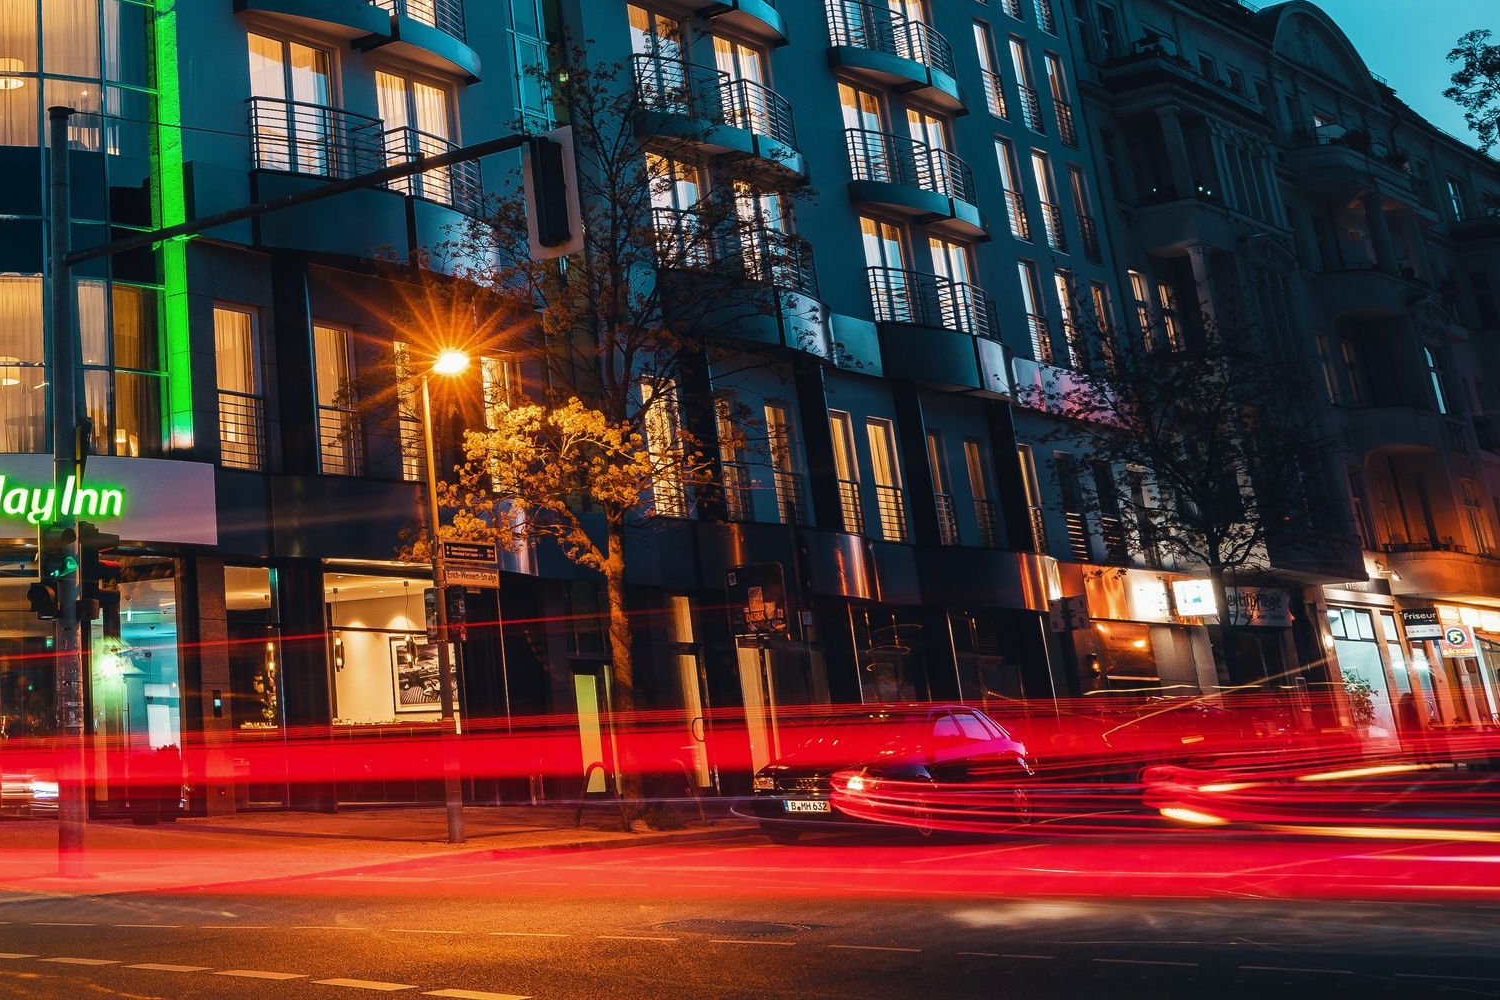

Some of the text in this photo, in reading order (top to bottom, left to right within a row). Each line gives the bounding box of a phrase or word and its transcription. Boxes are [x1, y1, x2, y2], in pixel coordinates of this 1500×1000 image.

[62, 475, 123, 516] Inn
[1403, 612, 1437, 620] Friseur
[812, 802, 828, 810] 632
